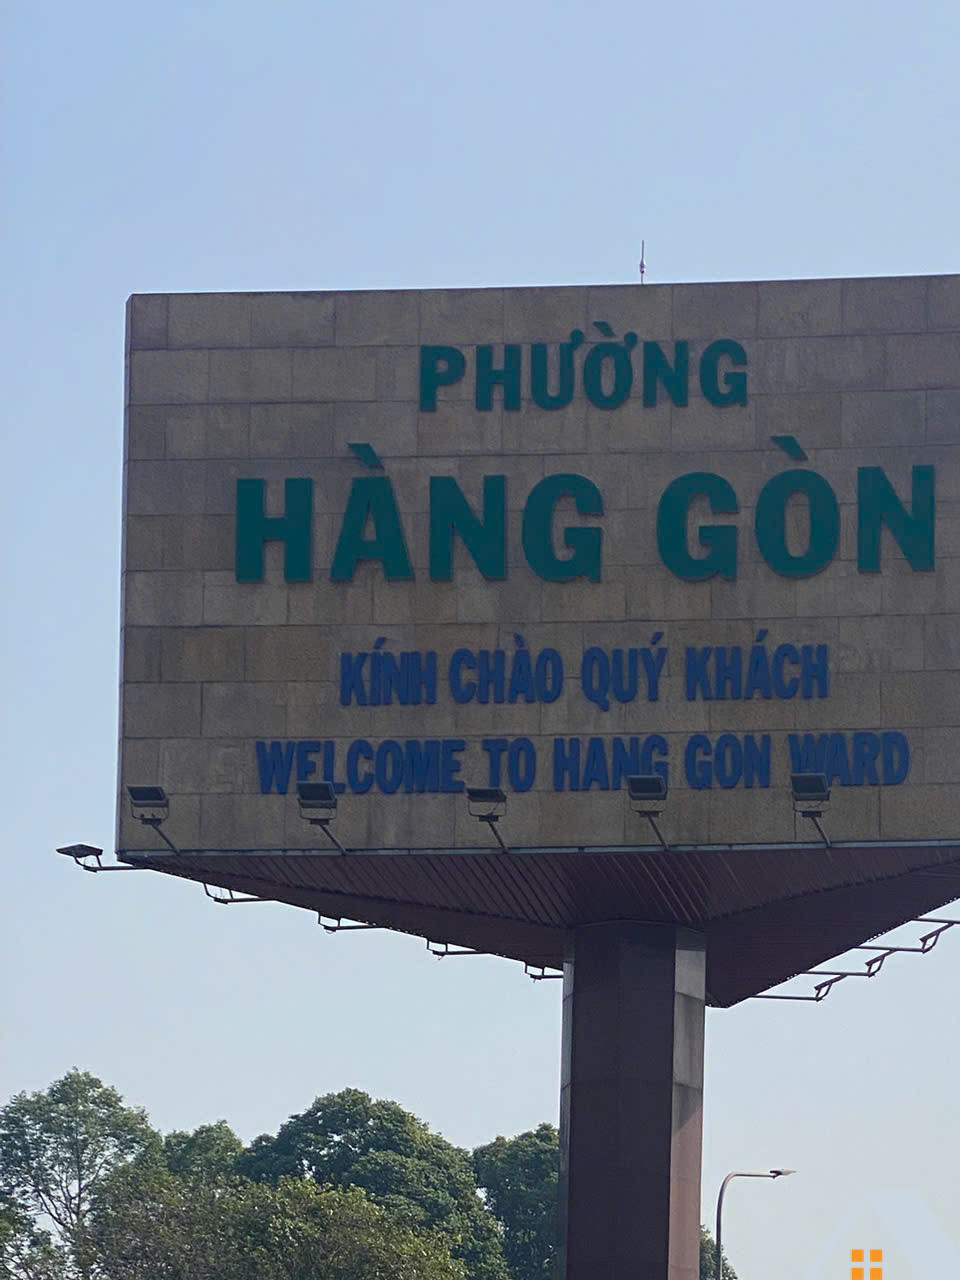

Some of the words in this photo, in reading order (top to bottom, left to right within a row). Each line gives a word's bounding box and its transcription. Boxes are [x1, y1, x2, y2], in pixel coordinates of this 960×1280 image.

[420, 322, 748, 413] PHƯỜNG
[235, 442, 603, 583] HÀNG
[656, 435, 936, 581] GÒN
[341, 637, 437, 706] KÍNH
[449, 633, 564, 704] CHÀO
[580, 632, 666, 712] QUÝ
[685, 629, 828, 701] KHÁCH
[255, 739, 467, 795] WELCOME
[481, 737, 537, 793] TO
[552, 733, 669, 792] HANG
[684, 733, 772, 790] GON
[787, 730, 912, 787] WARD
